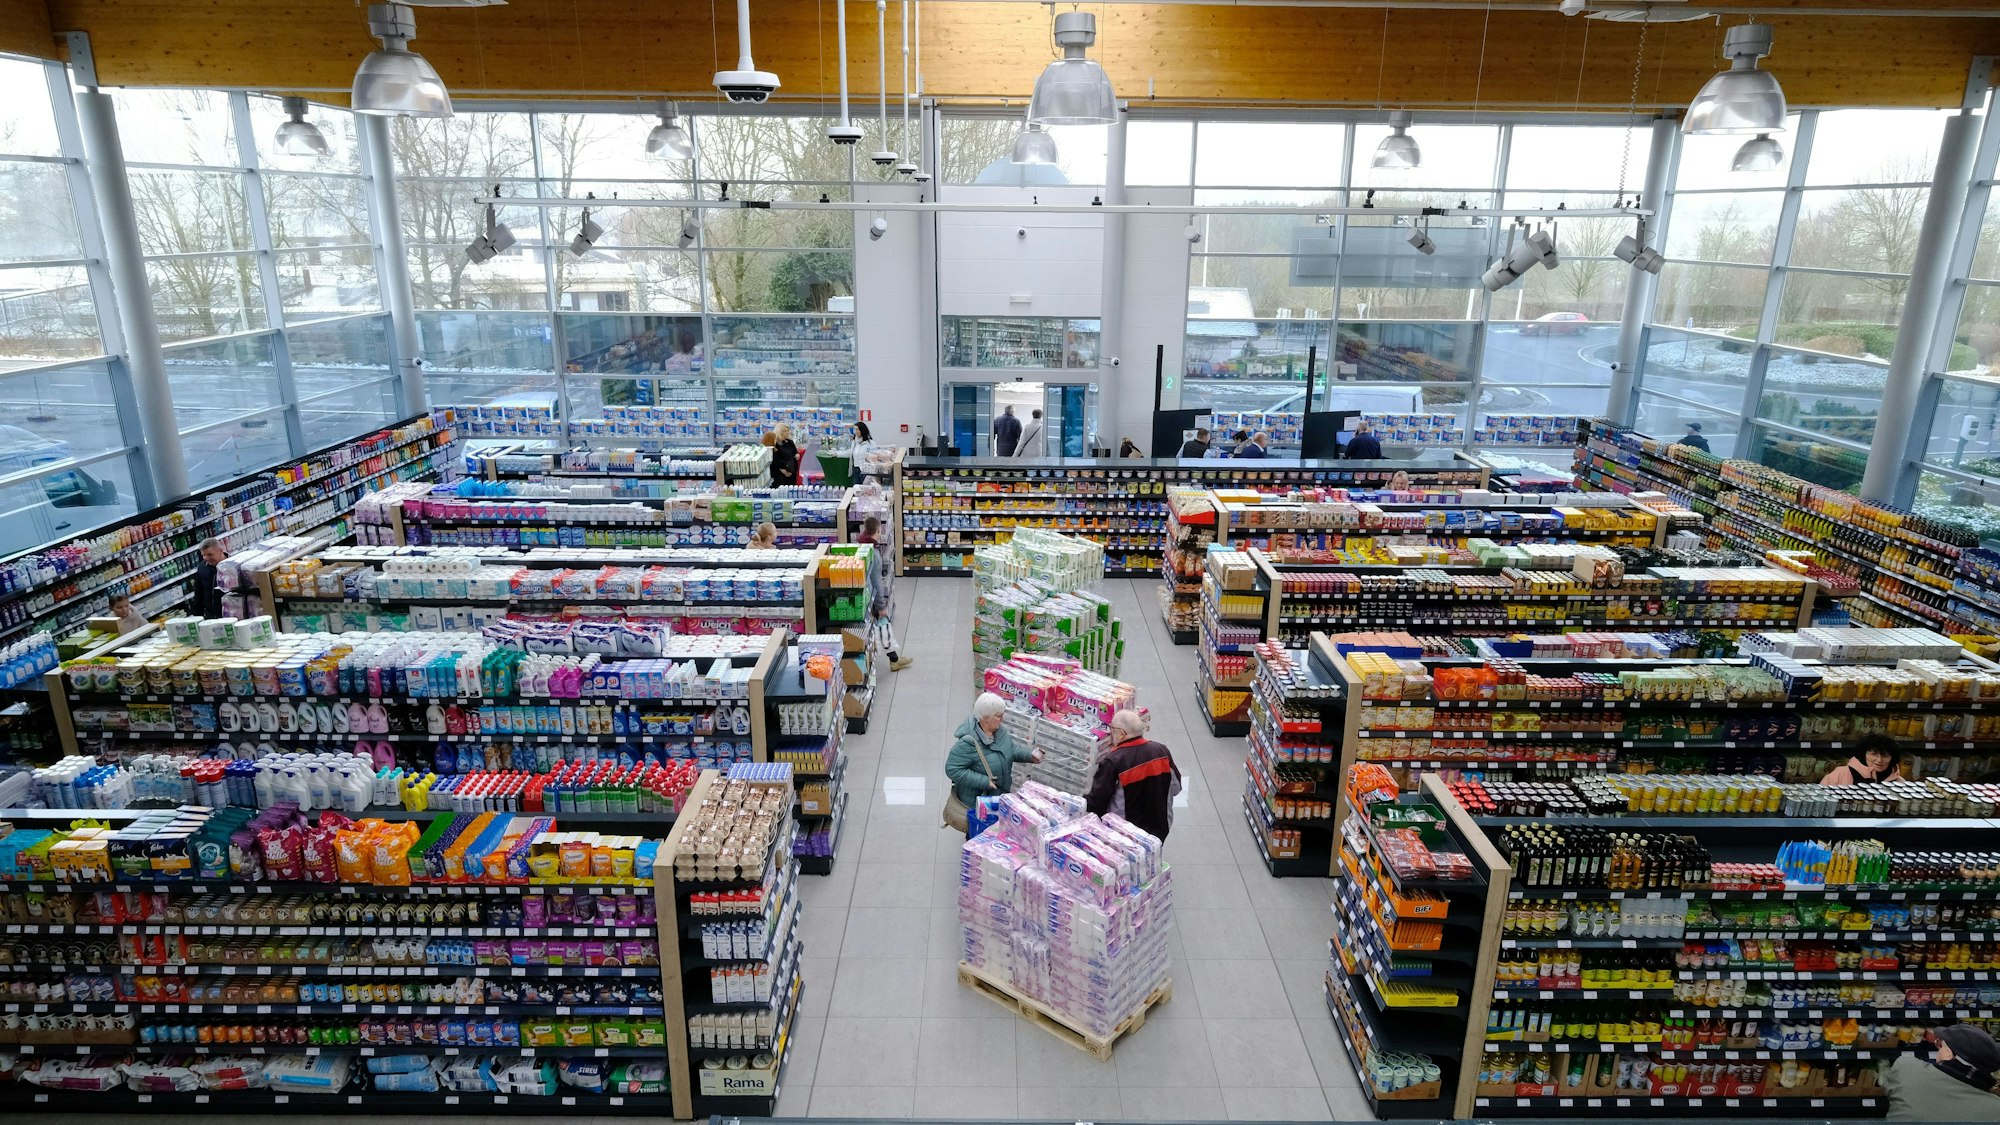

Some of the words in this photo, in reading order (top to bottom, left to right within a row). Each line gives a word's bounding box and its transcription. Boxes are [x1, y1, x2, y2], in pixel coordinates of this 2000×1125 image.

[1166, 377, 1174, 390] 2
[519, 584, 543, 593] design
[603, 583, 626, 592] design
[650, 584, 673, 593] design
[700, 620, 732, 631] weich
[761, 620, 791, 631] weich
[309, 670, 326, 680] Spee
[999, 682, 1029, 699] weich
[1068, 695, 1098, 714] weich
[1415, 906, 1432, 914] BiFi
[578, 1066, 598, 1074] STREU
[723, 1078, 765, 1089] Rama
